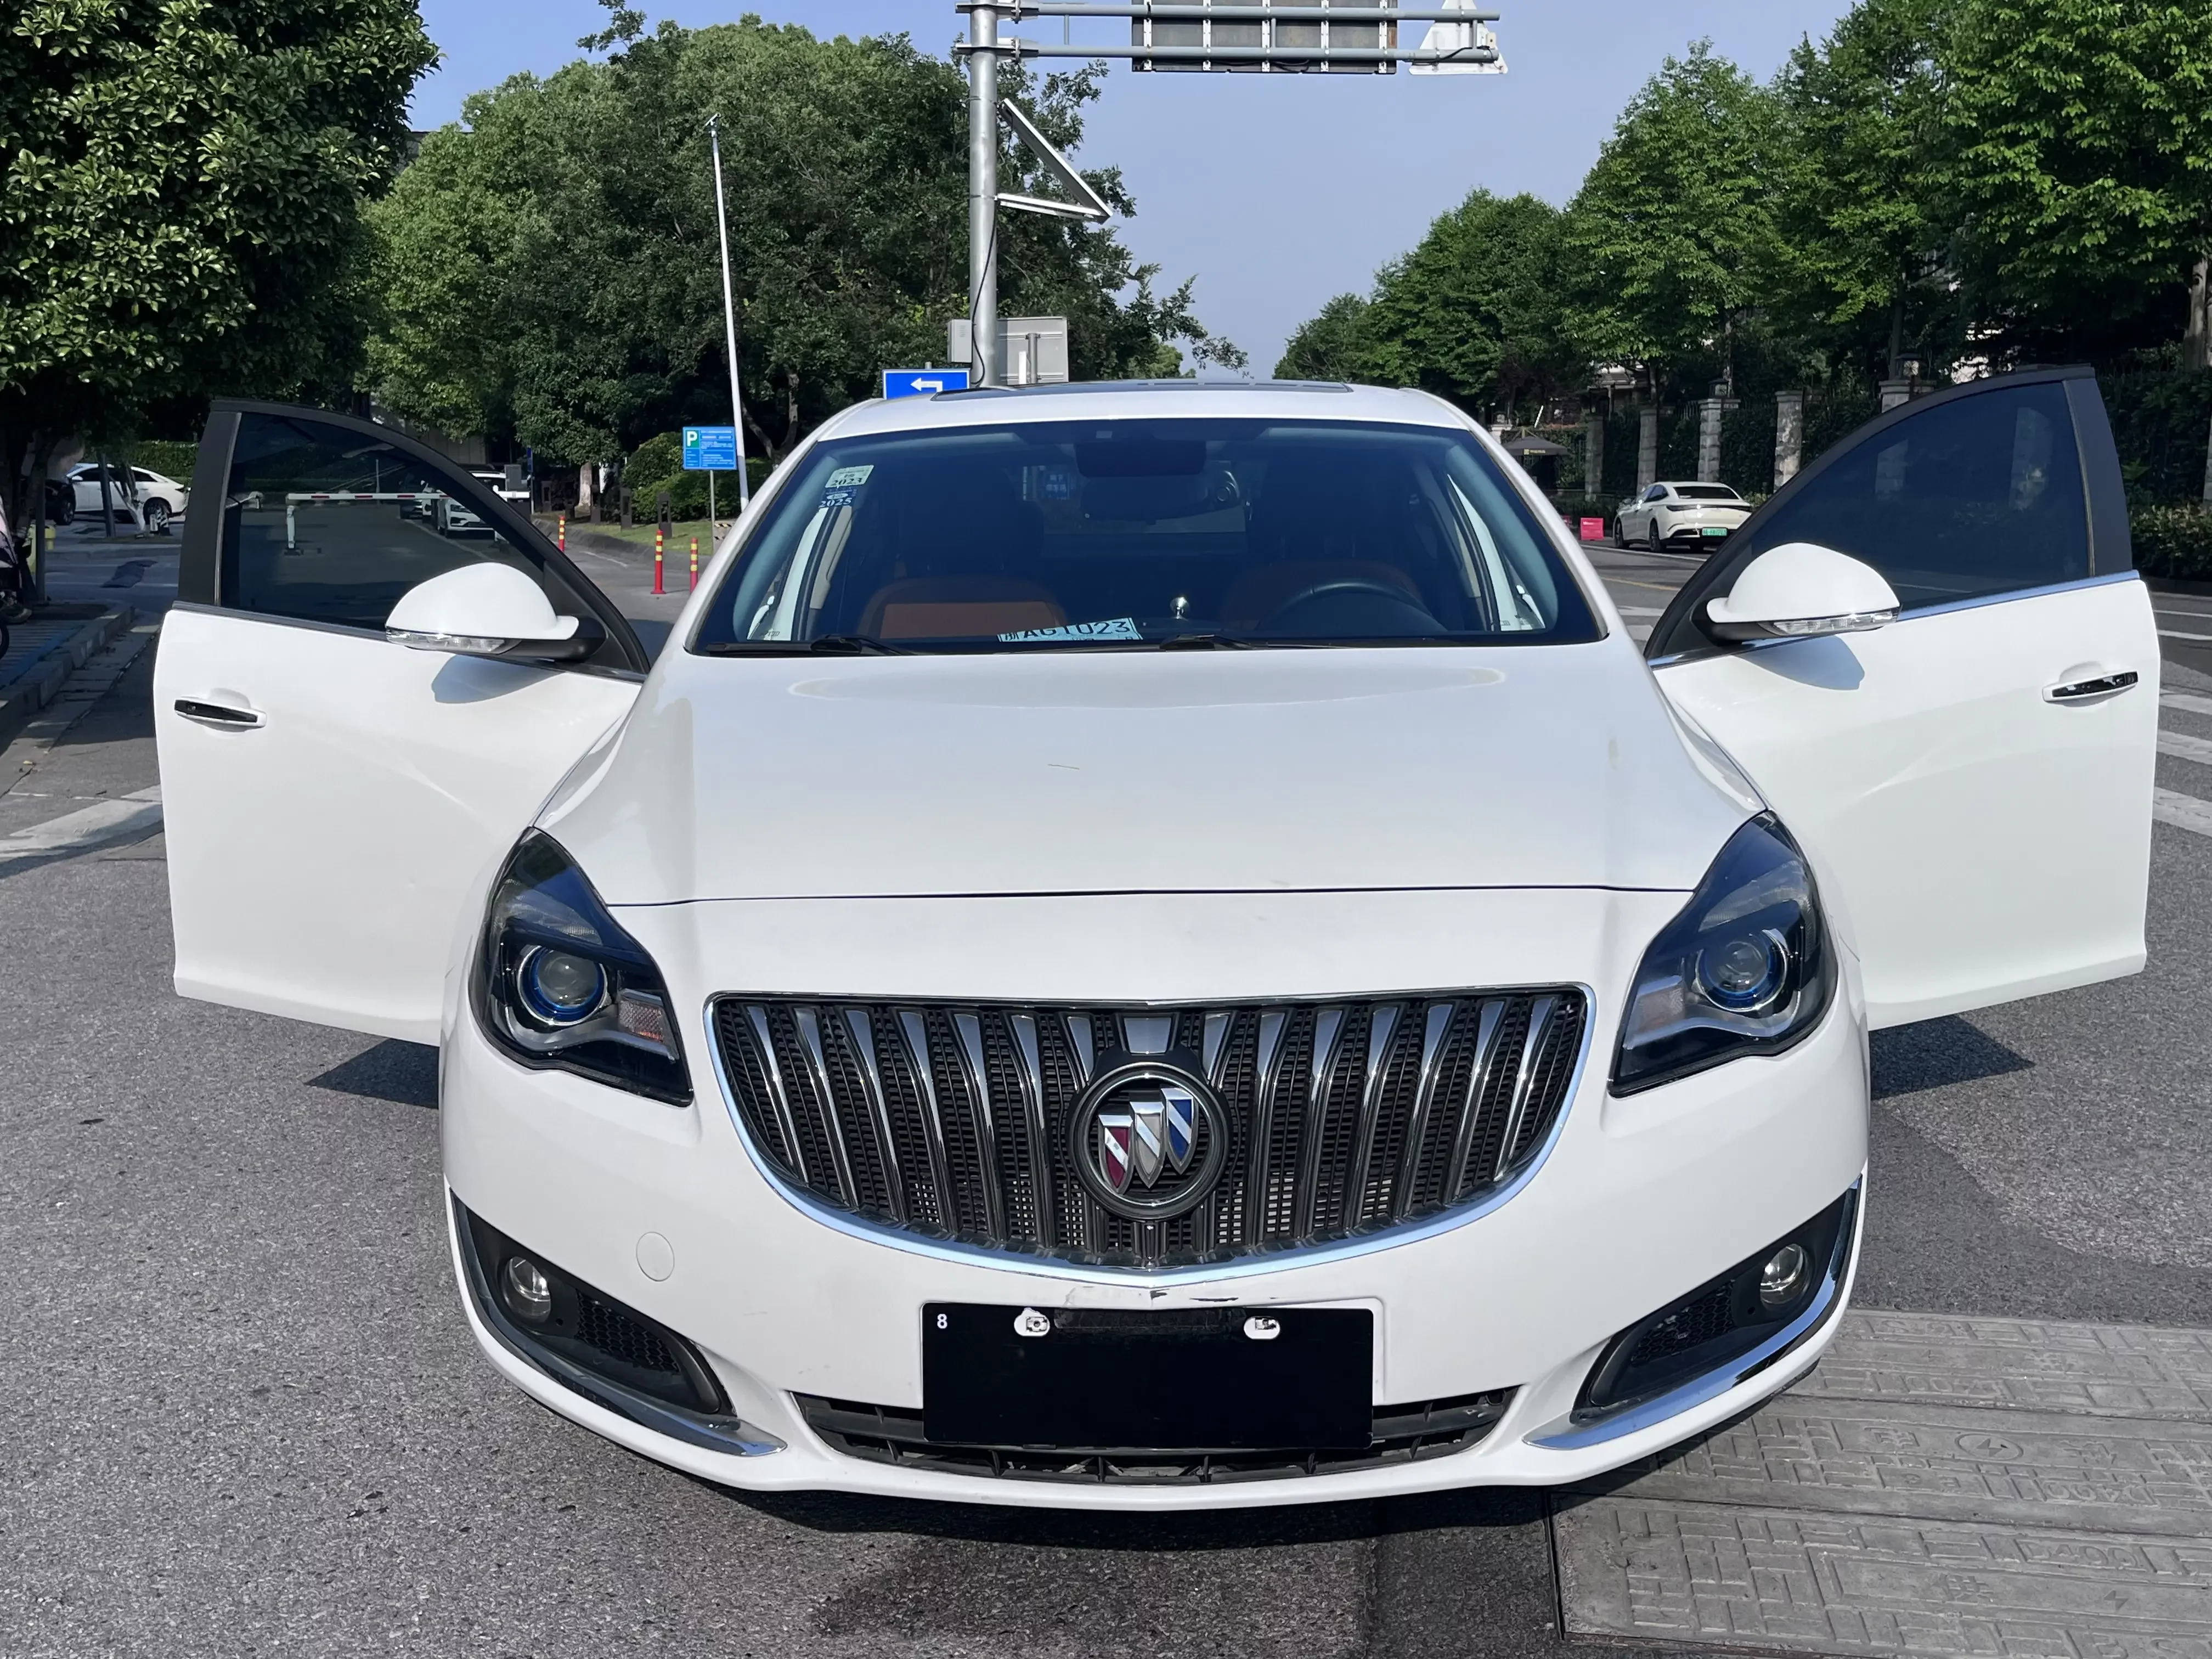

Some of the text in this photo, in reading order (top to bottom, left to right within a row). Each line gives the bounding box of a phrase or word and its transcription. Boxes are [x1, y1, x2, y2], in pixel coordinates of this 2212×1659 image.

[687, 431, 697, 447] P
[819, 498, 852, 507] 2025
[937, 1313, 947, 1329] 8
